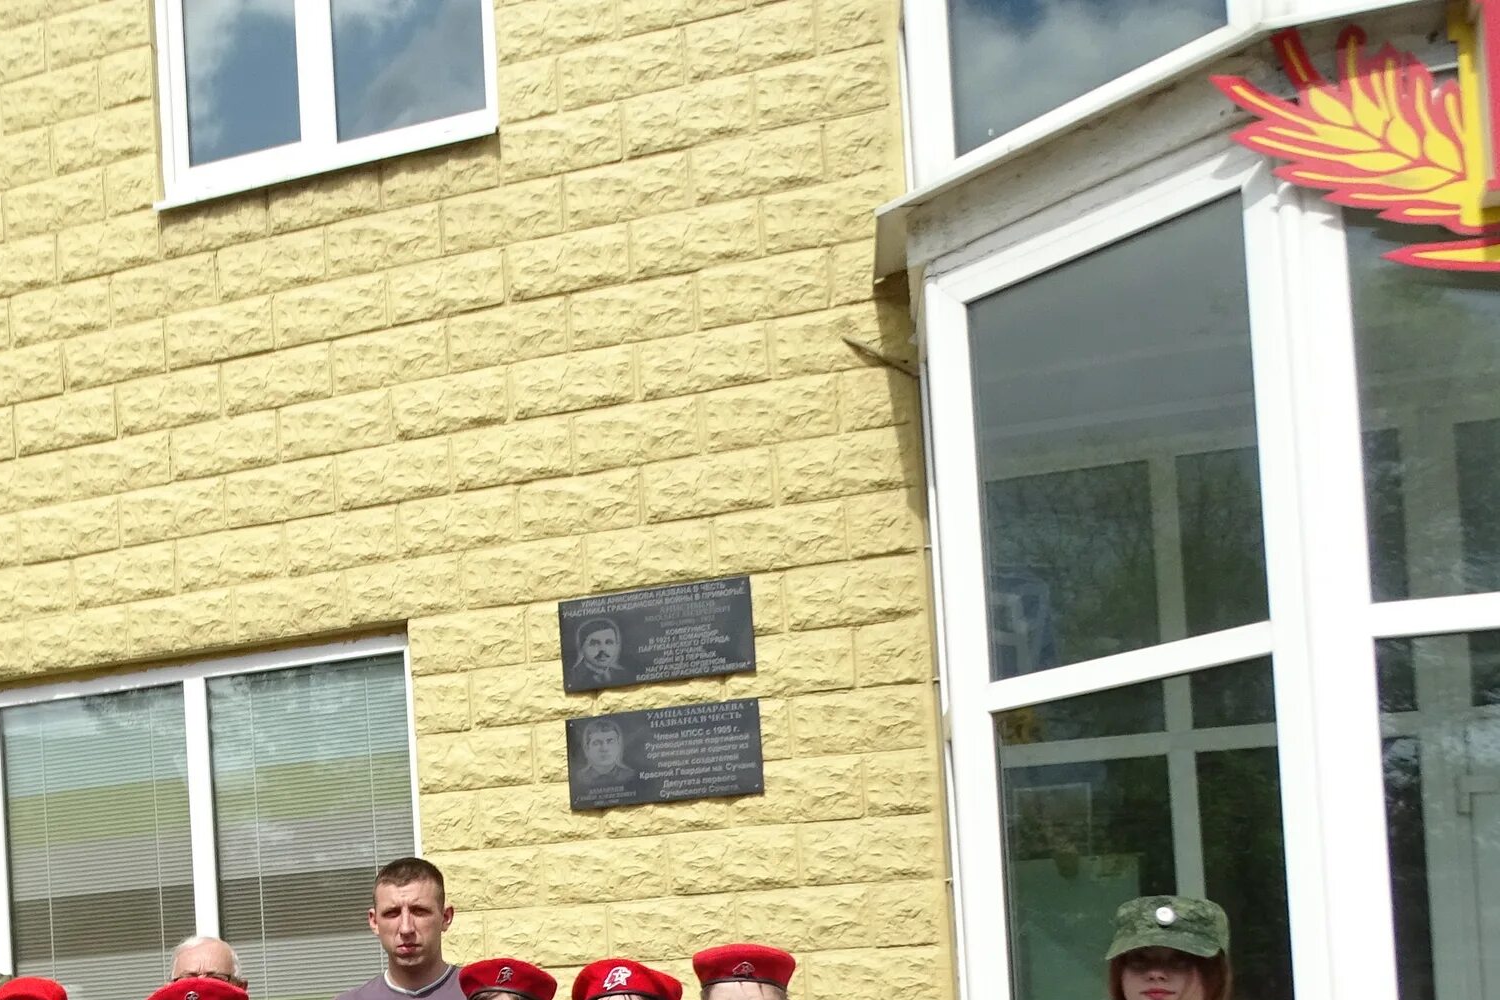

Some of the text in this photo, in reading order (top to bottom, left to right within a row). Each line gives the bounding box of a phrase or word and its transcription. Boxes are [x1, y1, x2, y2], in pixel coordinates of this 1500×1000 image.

[581, 597, 606, 608] УЛИЦА
[656, 585, 692, 598] НАЗВАНА
[692, 584, 699, 593] В
[700, 581, 726, 590] ЧЕСТЬ
[562, 606, 606, 618] УЧАСТНИКА
[663, 649, 674, 657] НА
[646, 702, 745, 720] УЛИЦА ЗАМАРАЕВА
[650, 711, 742, 728] НАЗВАНА В ЧЕСТЬ
[654, 732, 679, 741] Члена
[680, 728, 704, 738] КПСС
[645, 738, 703, 751] Руководителя
[639, 768, 674, 781] Красной
[663, 778, 701, 790] Депутата
